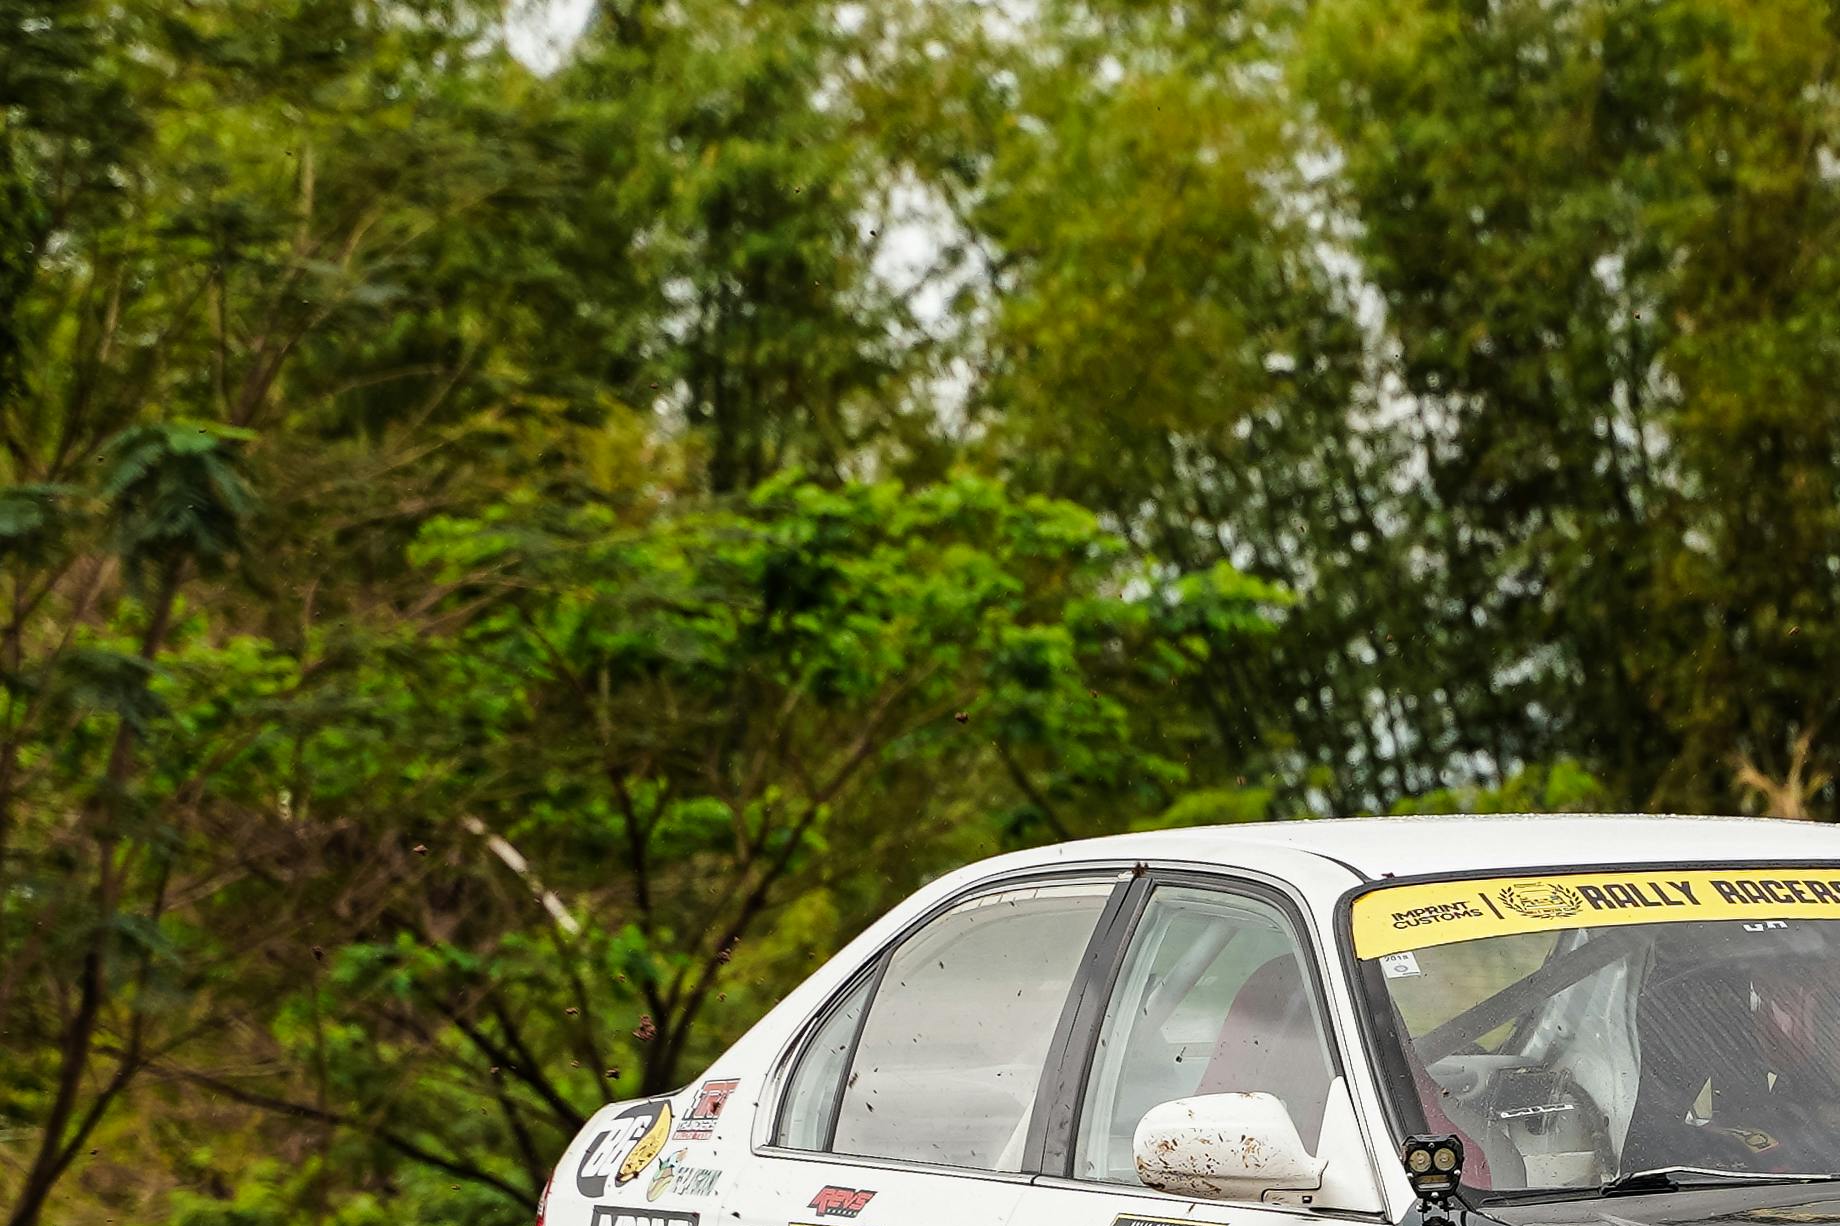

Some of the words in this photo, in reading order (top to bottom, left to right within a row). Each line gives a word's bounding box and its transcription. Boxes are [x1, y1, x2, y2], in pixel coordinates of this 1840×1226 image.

[1576, 880, 1701, 911] RALLY
[1391, 900, 1470, 921] IMPRINT
[1393, 908, 1483, 929] CUSTOMS
